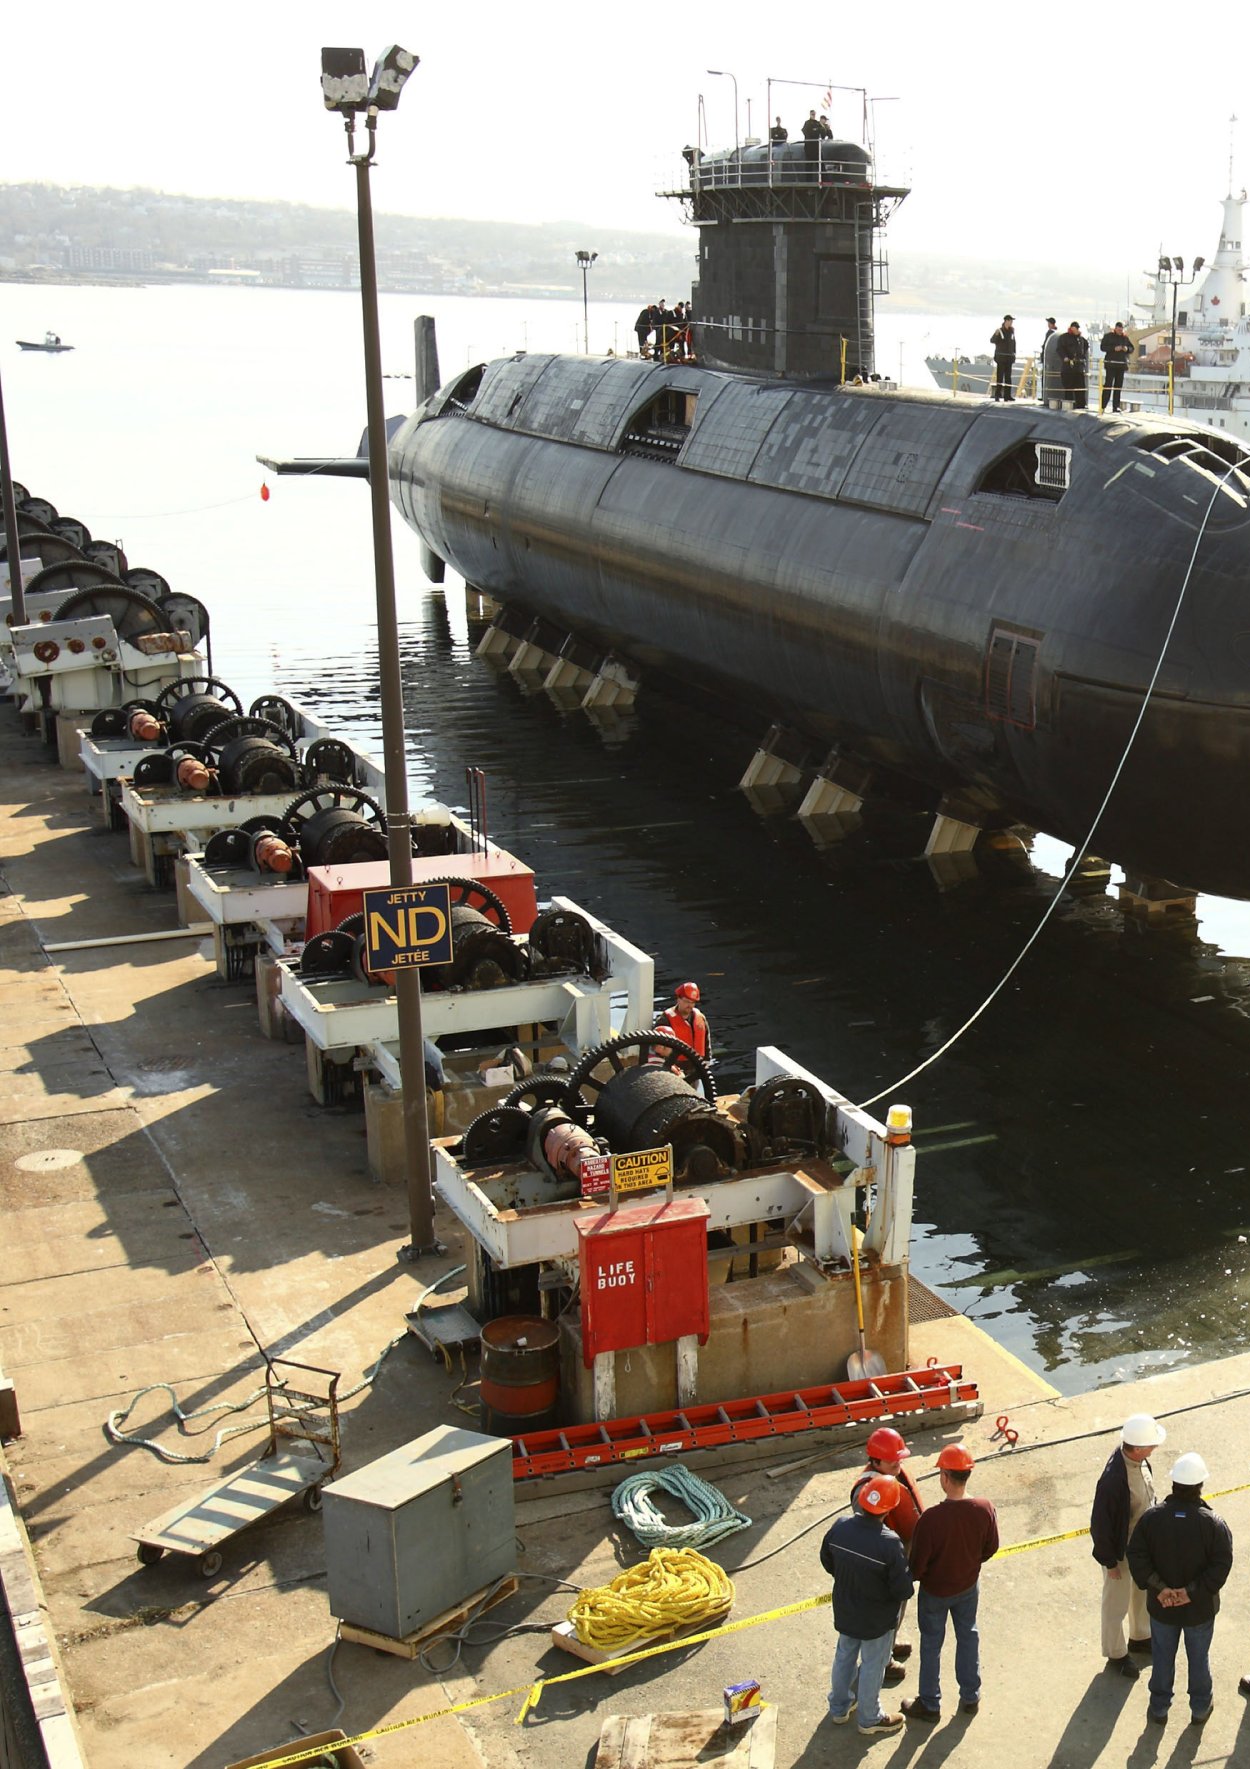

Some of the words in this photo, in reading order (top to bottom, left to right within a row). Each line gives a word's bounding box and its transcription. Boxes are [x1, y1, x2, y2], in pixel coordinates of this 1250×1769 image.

[387, 891, 427, 906] JETTY
[370, 906, 447, 951] ND
[391, 949, 430, 965] JETÉE
[617, 1152, 667, 1169] CAUTION
[618, 1169, 634, 1177] HARD
[635, 1167, 650, 1175] HATS
[620, 1173, 649, 1183] REQUIRED
[624, 1181, 637, 1189] THIS
[598, 1261, 634, 1277] LIFE
[597, 1273, 636, 1290] BUOY
[375, 1720, 406, 1734] CAUTION
[422, 1707, 454, 1721] WORKING
